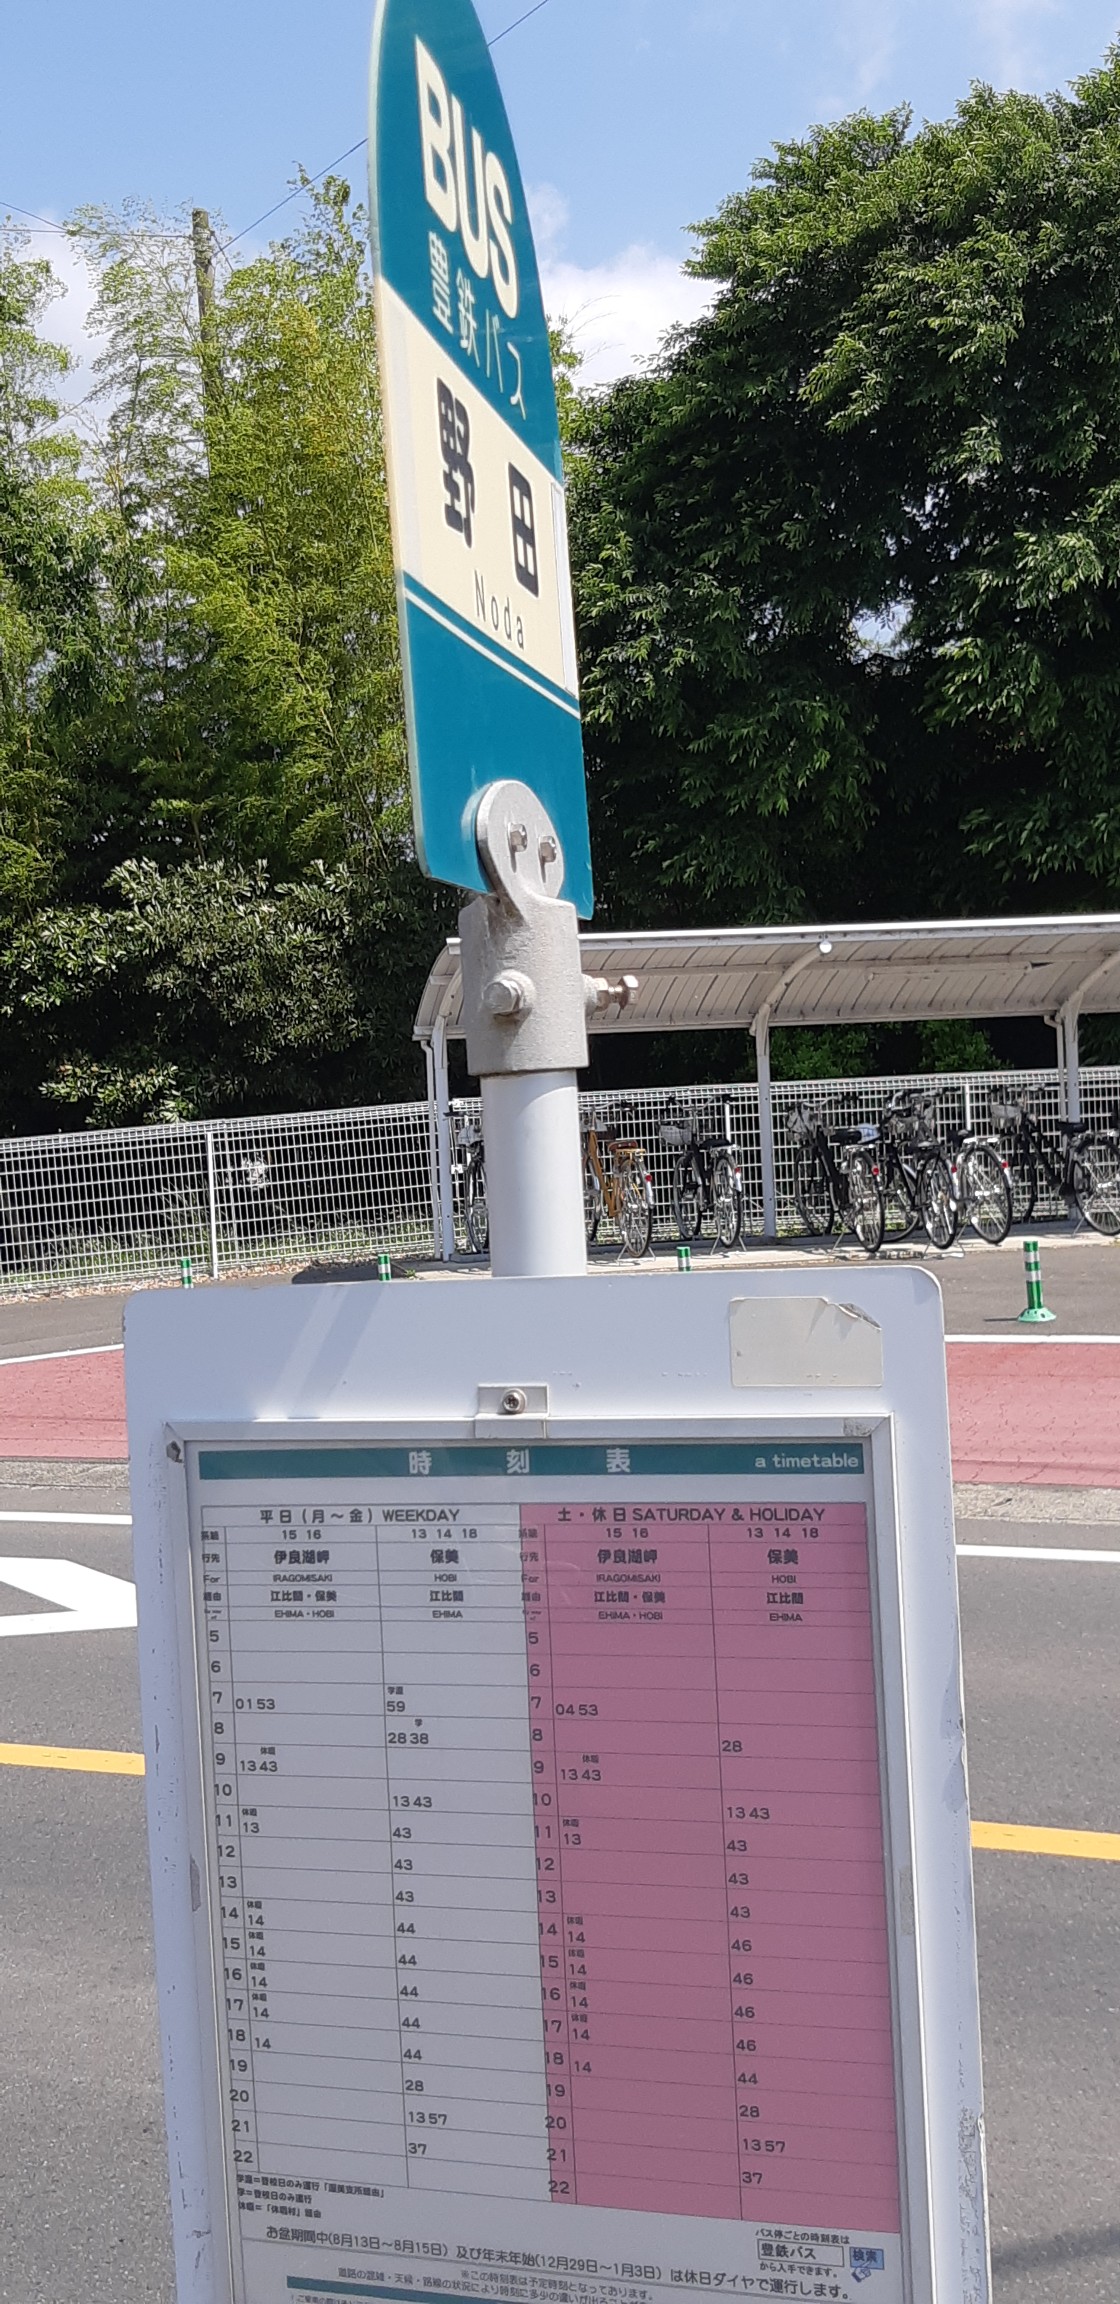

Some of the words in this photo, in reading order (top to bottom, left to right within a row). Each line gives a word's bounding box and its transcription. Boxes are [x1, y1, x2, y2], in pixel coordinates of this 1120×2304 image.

[415, 36, 518, 319] BUS
[429, 231, 527, 420] 豊鉄バス
[437, 376, 540, 597] 野田
[474, 569, 525, 651] Noda
[755, 1456, 766, 1468] a
[772, 1453, 859, 1468] timetable
[383, 1509, 460, 1522] WEEKDAY
[633, 1508, 726, 1522] SATURDAY
[732, 1508, 744, 1522] &
[750, 1508, 825, 1521] HOLIDAY
[282, 1529, 297, 1540] 15
[306, 1529, 321, 1540] 16
[411, 1529, 427, 1539] 13
[436, 1529, 452, 1539] 14
[462, 1528, 477, 1539] 18
[606, 1528, 622, 1538] 15
[632, 1528, 649, 1538] 16
[747, 1528, 763, 1538] 13
[774, 1528, 791, 1538] 14
[802, 1528, 819, 1538] 18
[274, 1550, 329, 1564] 伊良湖岬
[430, 1550, 459, 1564] 保美
[597, 1549, 657, 1564] 伊良湖岬
[767, 1549, 799, 1565] 保美
[203, 1574, 220, 1584] For
[273, 1574, 333, 1582] IRAGOMISAKI
[434, 1574, 457, 1582] HOBI
[521, 1574, 540, 1583] For
[596, 1574, 661, 1582] IRAGOMISAKI
[771, 1575, 796, 1583] HOBI
[432, 1610, 462, 1619] EHIMA
[769, 1613, 803, 1622] EHIMA
[210, 1631, 219, 1642] 5
[528, 1633, 539, 1644] 5
[211, 1661, 221, 1672] 6
[530, 1665, 540, 1676] 6
[212, 1692, 222, 1703] 7
[531, 1697, 541, 1708] 7
[236, 1699, 252, 1709] 01
[257, 1699, 275, 1709] 53
[387, 1701, 405, 1712] 59
[556, 1705, 575, 1715] 04
[578, 1705, 598, 1715] 53
[214, 1723, 224, 1734] 8
[388, 1732, 406, 1744] 28
[410, 1733, 428, 1744] 38
[532, 1729, 543, 1741] 8
[722, 1741, 742, 1752] 28
[215, 1754, 226, 1765] 9
[241, 1761, 256, 1771] 13
[259, 1761, 278, 1772] 43
[534, 1762, 544, 1773] 9
[561, 1770, 577, 1780] 13
[581, 1770, 601, 1781] 43
[214, 1784, 232, 1796] 10
[393, 1796, 410, 1807] 13
[413, 1797, 432, 1808] 43
[533, 1793, 552, 1806] 10
[727, 1807, 746, 1819] 13
[750, 1807, 770, 1819] 43
[216, 1815, 233, 1827] 11
[243, 1823, 259, 1833] 13
[393, 1827, 411, 1839] 43
[535, 1826, 552, 1838] 11
[563, 1833, 581, 1845] 13
[218, 1846, 235, 1858] 12
[727, 1840, 747, 1852] 43
[394, 1859, 413, 1870] 43
[536, 1858, 555, 1871] 12
[219, 1877, 237, 1889] 13
[728, 1873, 749, 1885] 43
[396, 1891, 414, 1902] 43
[538, 1891, 556, 1903] 13
[221, 1907, 239, 1919] 14
[730, 1906, 750, 1918] 43
[248, 1915, 264, 1926] 14
[397, 1923, 416, 1934] 44
[539, 1923, 557, 1935] 14
[222, 1937, 240, 1949] 15
[568, 1931, 585, 1943] 14
[250, 1945, 265, 1957] 14
[731, 1939, 752, 1952] 46
[398, 1955, 417, 1966] 44
[540, 1955, 558, 1968] 15
[224, 1968, 242, 1980] 16
[570, 1964, 587, 1976] 14
[251, 1976, 267, 1988] 14
[733, 1973, 753, 1985] 46
[400, 1986, 419, 1997] 44
[542, 1987, 560, 2000] 16
[226, 1999, 243, 2011] 17
[571, 1996, 588, 2008] 14
[253, 2007, 269, 2019] 14
[735, 2006, 755, 2019] 46
[402, 2017, 420, 2028] 44
[543, 2020, 561, 2033] 17
[228, 2029, 245, 2041] 18
[572, 2028, 590, 2041] 14
[255, 2038, 271, 2049] 14
[736, 2040, 756, 2052] 46
[404, 2049, 422, 2060] 44
[545, 2052, 563, 2065] 18
[230, 2059, 247, 2072] 19
[574, 2061, 592, 2073] 14
[738, 2073, 758, 2084] 44
[405, 2080, 424, 2092] 28
[546, 2084, 565, 2097] 19
[230, 2090, 249, 2102] 20
[739, 2105, 759, 2118] 28
[409, 2112, 425, 2123] 13
[428, 2113, 447, 2125] 57
[545, 2117, 566, 2129] 20
[232, 2120, 249, 2132] 21
[408, 2143, 427, 2155] 37
[743, 2139, 761, 2151] 13
[765, 2140, 785, 2152] 57
[233, 2151, 253, 2163] 22
[547, 2148, 567, 2161] 21
[742, 2172, 762, 2184] 37
[548, 2181, 569, 2194] 22
[756, 2228, 850, 2244] バス停ごとの時刻表は
[761, 2243, 816, 2260] 豊鉄バス
[853, 2250, 878, 2263] 検索
[760, 2262, 838, 2278] から入手できます。
